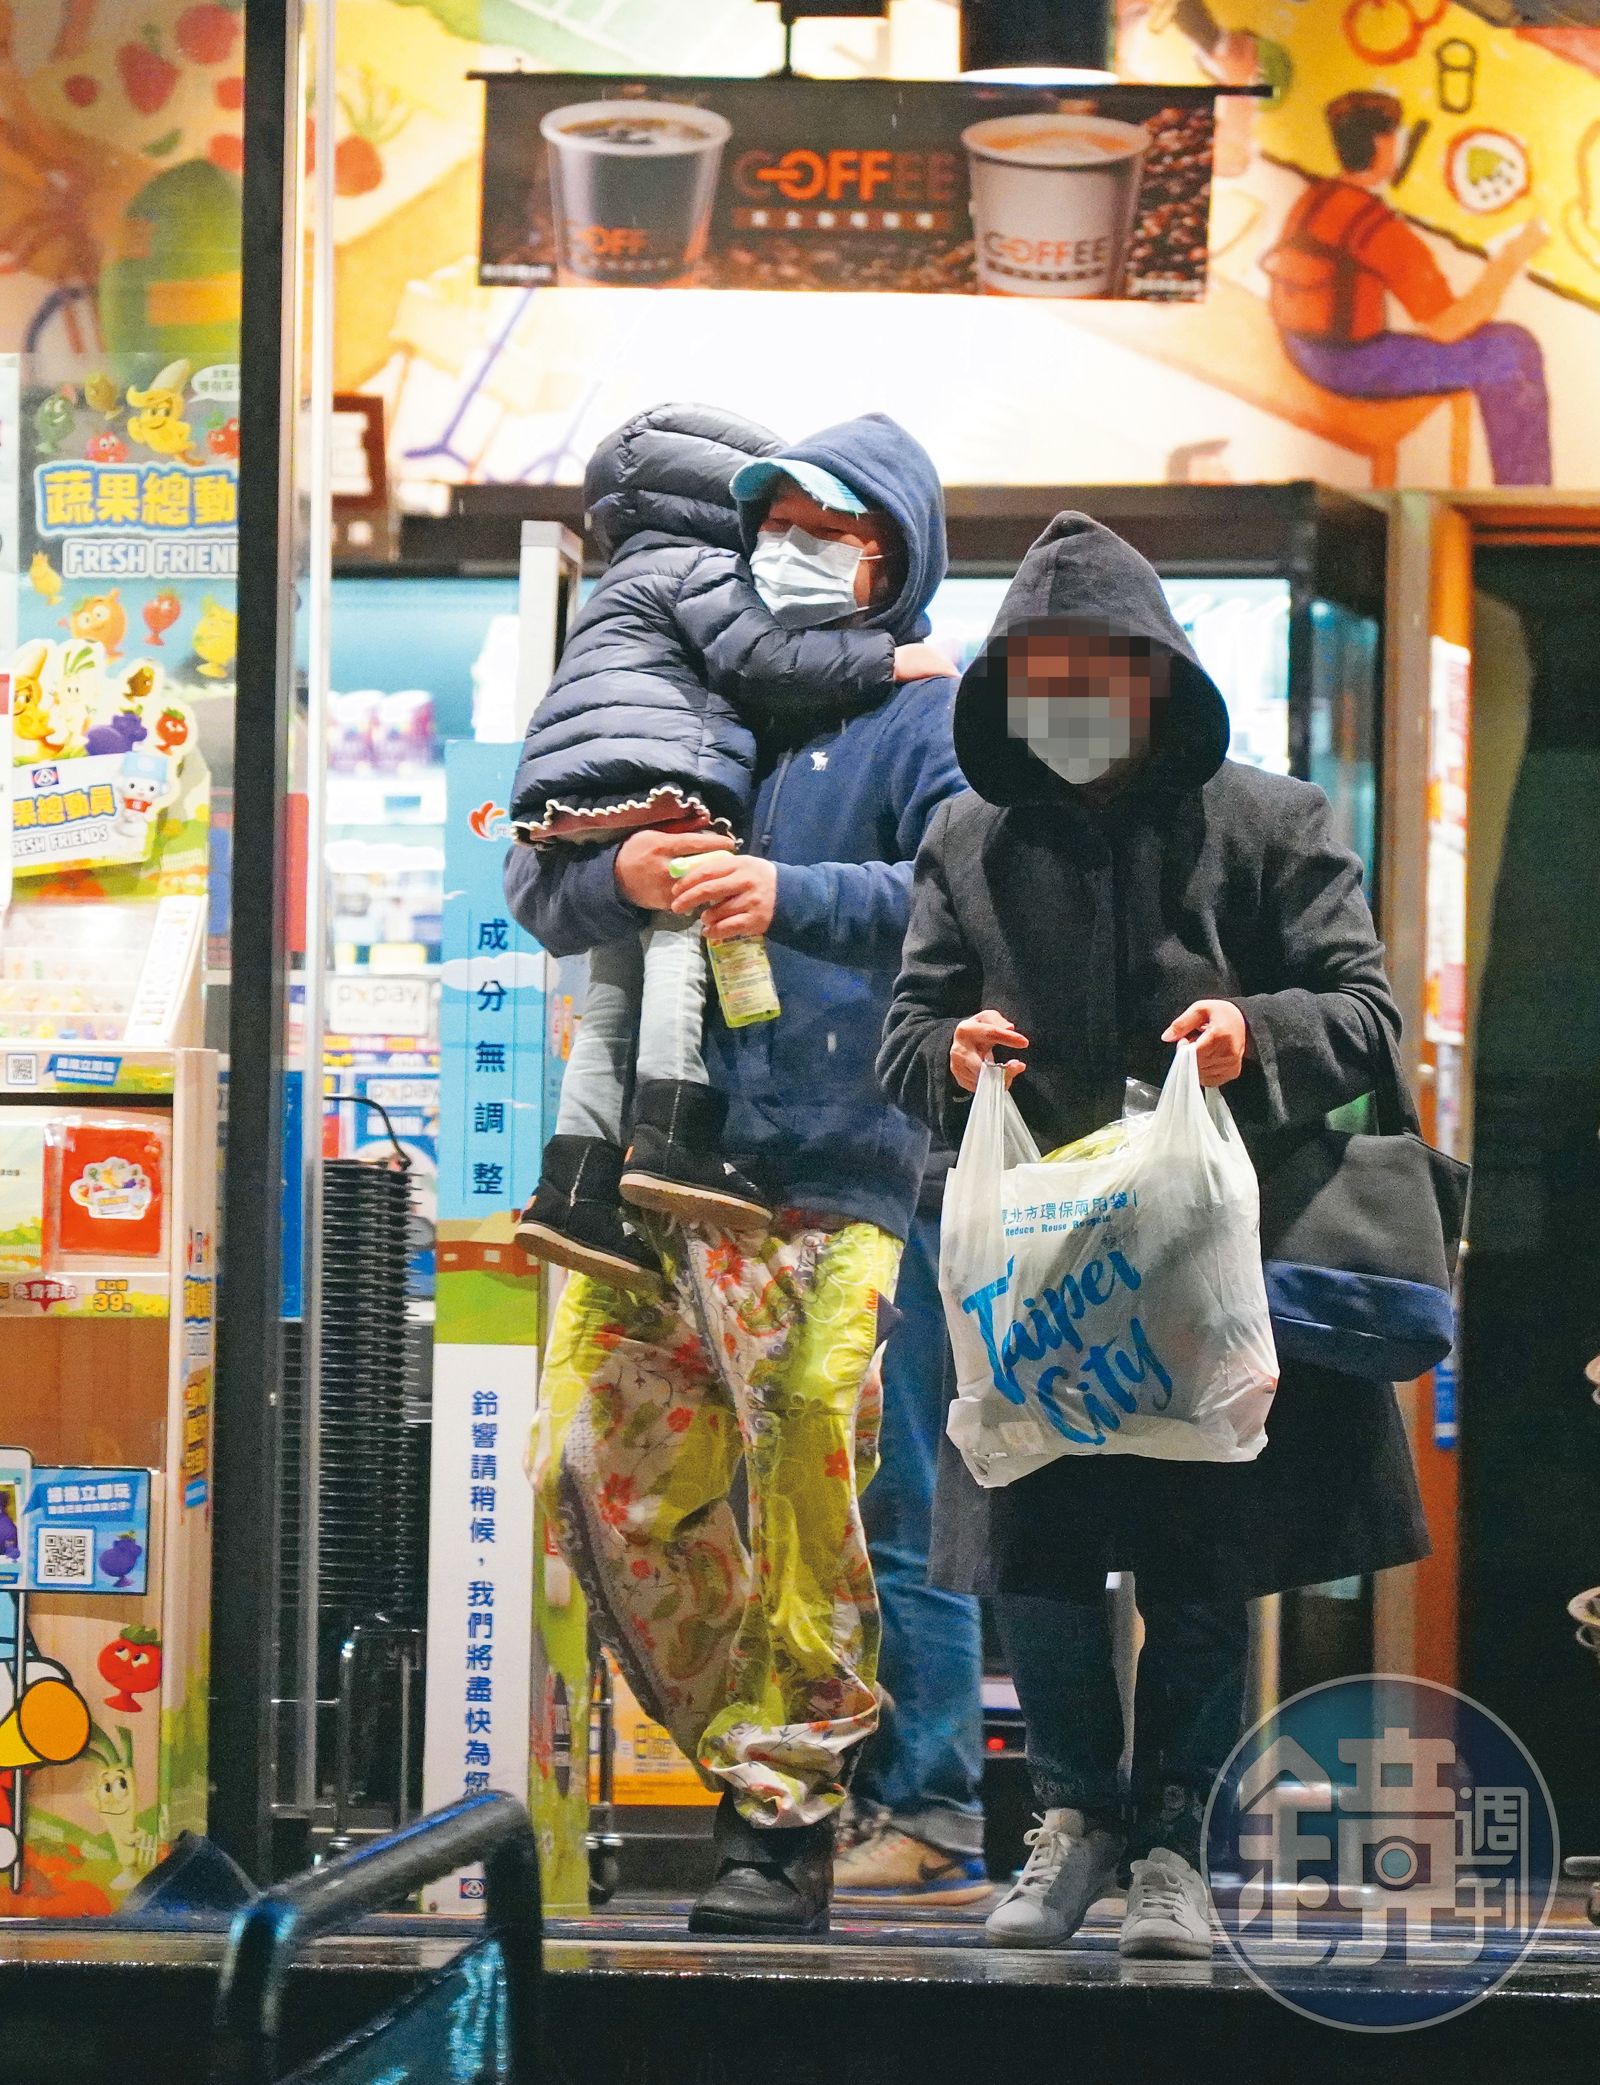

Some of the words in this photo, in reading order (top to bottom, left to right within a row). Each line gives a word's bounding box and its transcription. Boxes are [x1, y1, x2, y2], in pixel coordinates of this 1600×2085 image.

[732, 149, 957, 201] COFFEE
[67, 542, 147, 574] FRESH
[51, 824, 109, 850] FRIENDS
[472, 916, 509, 1197] 成分無調整
[1004, 1225, 1035, 1237] Reduce
[1041, 1222, 1067, 1233] Reuse
[961, 1250, 1142, 1406] Taipei
[1037, 1316, 1173, 1446] City
